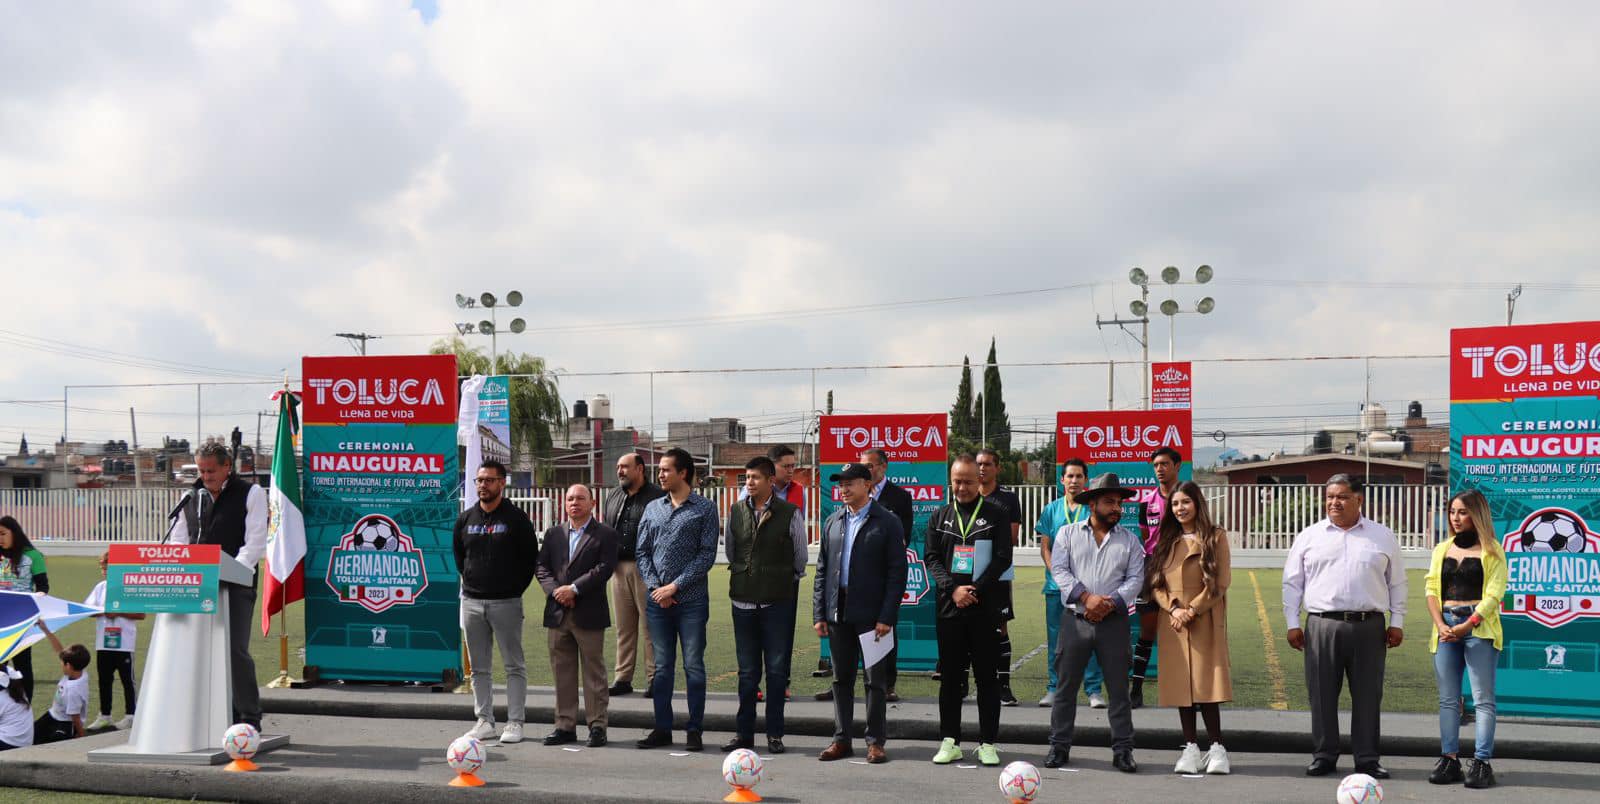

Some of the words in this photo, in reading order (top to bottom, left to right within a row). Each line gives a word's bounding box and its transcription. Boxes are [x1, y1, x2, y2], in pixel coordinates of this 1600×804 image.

[1153, 373, 1189, 381] TOLUCA
[308, 378, 445, 405] TOLUCA
[1501, 420, 1600, 431] CEREMONI
[830, 426, 943, 448] TOLUCA
[1062, 425, 1183, 448] TOLUCA
[338, 442, 415, 451] CEREMONIA
[1465, 437, 1600, 456] INAUGUR
[312, 455, 441, 472] INAUGURAL
[1465, 464, 1496, 474] TORNEO
[1499, 463, 1562, 474] INTERNACIONAL
[1566, 463, 1576, 473] DE
[138, 547, 190, 558] TOLUCA
[334, 554, 420, 577] HERMANDAD
[1508, 556, 1600, 583] ERMANDA
[125, 575, 200, 585] INAUGURAL
[336, 576, 371, 584] TOLUCA
[378, 577, 417, 585] SAITAMA
[1505, 583, 1545, 592] OLUCA
[368, 590, 385, 598] 2023
[1541, 600, 1564, 610] 2023
